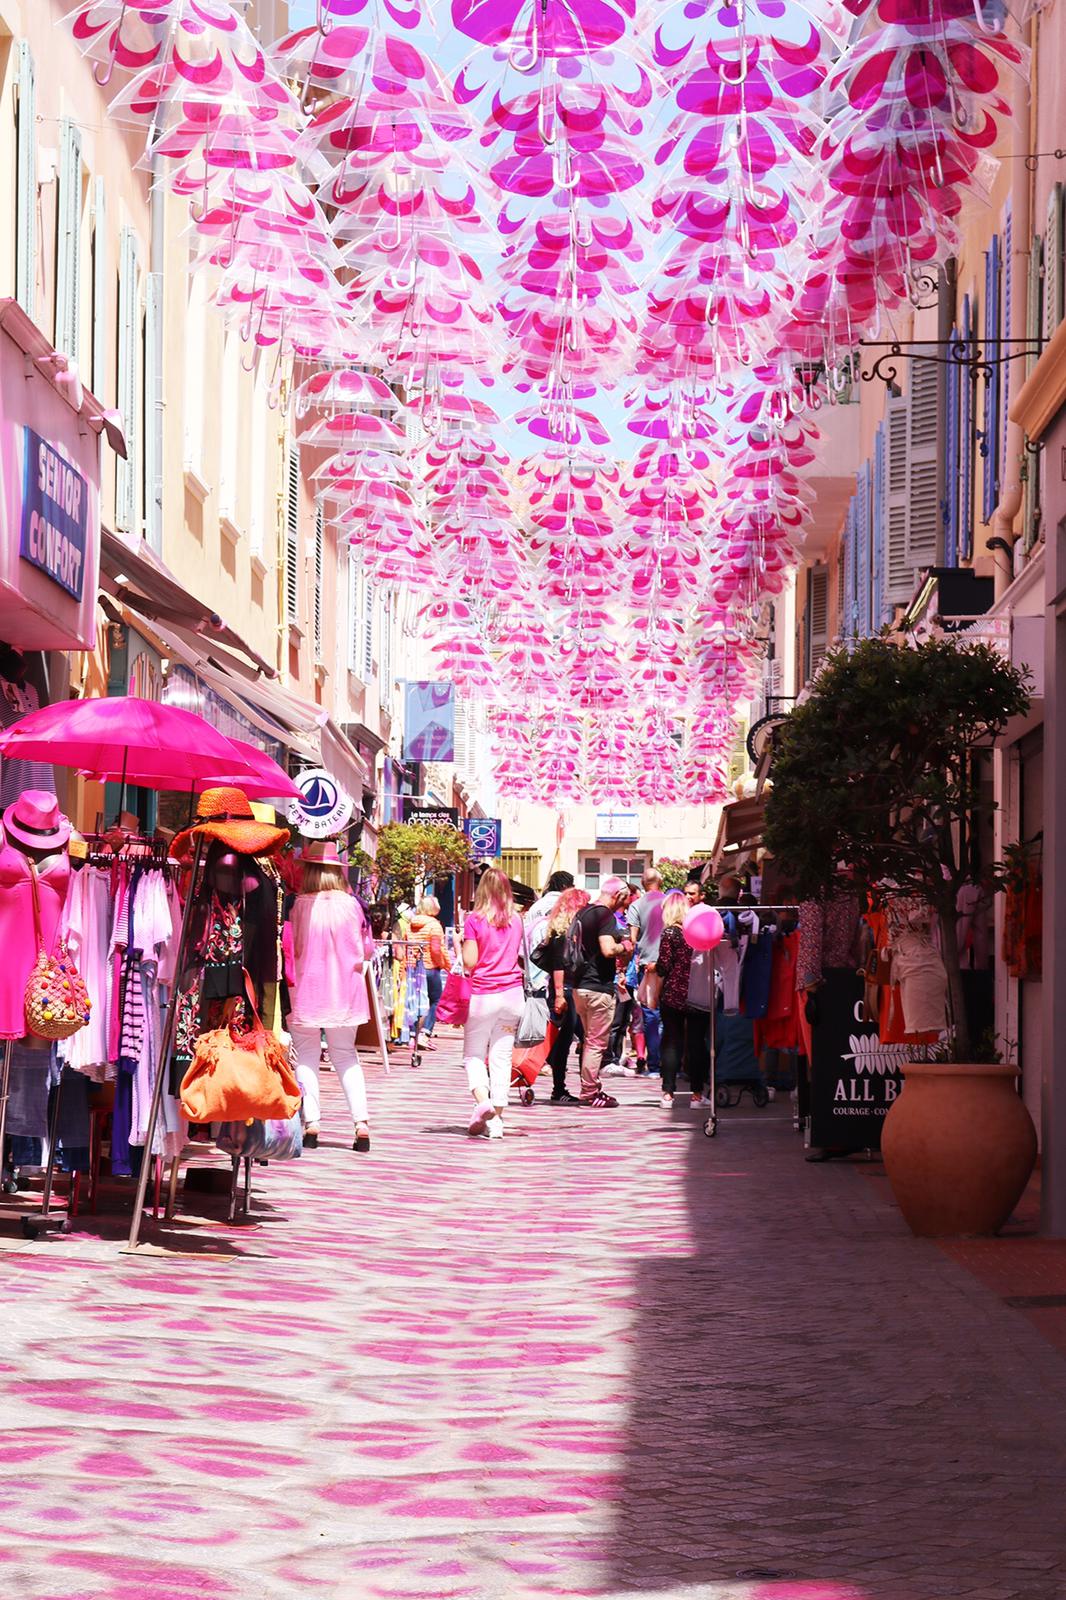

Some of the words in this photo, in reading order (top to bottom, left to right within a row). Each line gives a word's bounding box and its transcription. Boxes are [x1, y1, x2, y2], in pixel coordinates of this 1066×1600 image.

[38, 443, 82, 524] SENIOR
[29, 510, 82, 592] CONFORT
[289, 803, 310, 826] PETIT
[314, 803, 347, 829] BATEAU
[833, 1078, 874, 1101] ALL
[832, 1107, 870, 1116] COURAGE
